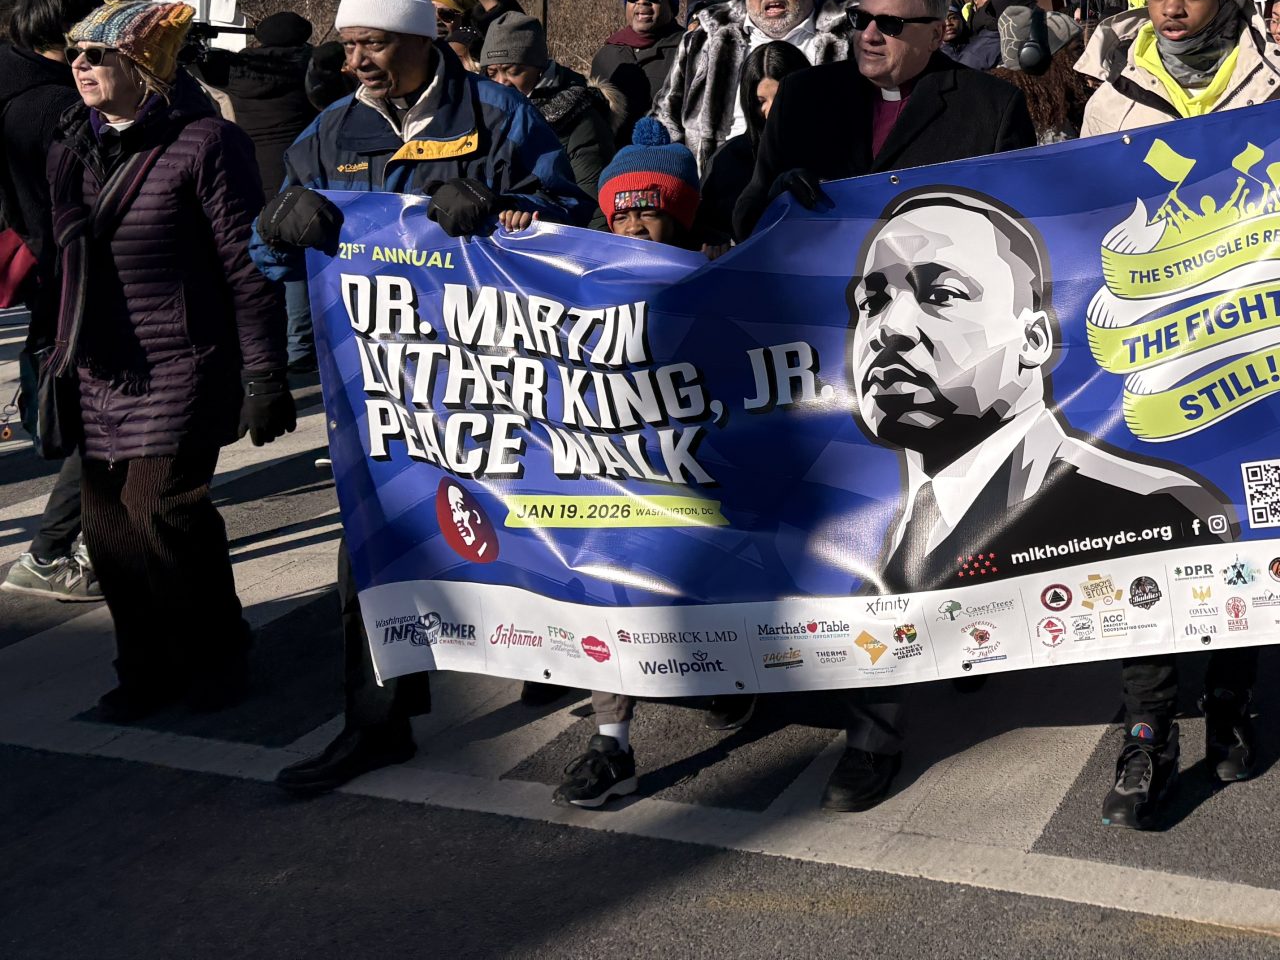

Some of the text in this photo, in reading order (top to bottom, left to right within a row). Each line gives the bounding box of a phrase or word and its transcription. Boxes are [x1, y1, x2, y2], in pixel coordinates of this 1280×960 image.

[339, 242, 455, 269] 21ST ANNUAL
[1129, 268, 1161, 284] THE
[1164, 236, 1242, 279] STRUGGLE
[1246, 233, 1259, 247] IS
[340, 273, 647, 365] DR. MARTIN
[1122, 322, 1180, 364] THE
[358, 336, 836, 430] LUTHER KING, JR.
[1179, 355, 1280, 420] STILL!
[364, 399, 716, 485] PEACE WALK
[516, 504, 554, 519] JAN
[701, 507, 714, 516] DC
[1011, 525, 1173, 565] mlkholidaydc.org
[1184, 563, 1214, 577] DPR
[866, 596, 910, 616] xfinity
[965, 604, 990, 614] Casey
[375, 614, 416, 629] Washington
[1103, 614, 1123, 623] ACC
[758, 620, 850, 636] Martha's Table
[632, 630, 738, 644] REDBRICK LMD
[815, 650, 848, 658] THERME
[819, 656, 847, 664] GROUP
[897, 651, 922, 660] DREAMS
[639, 658, 724, 676] Wellpoint
